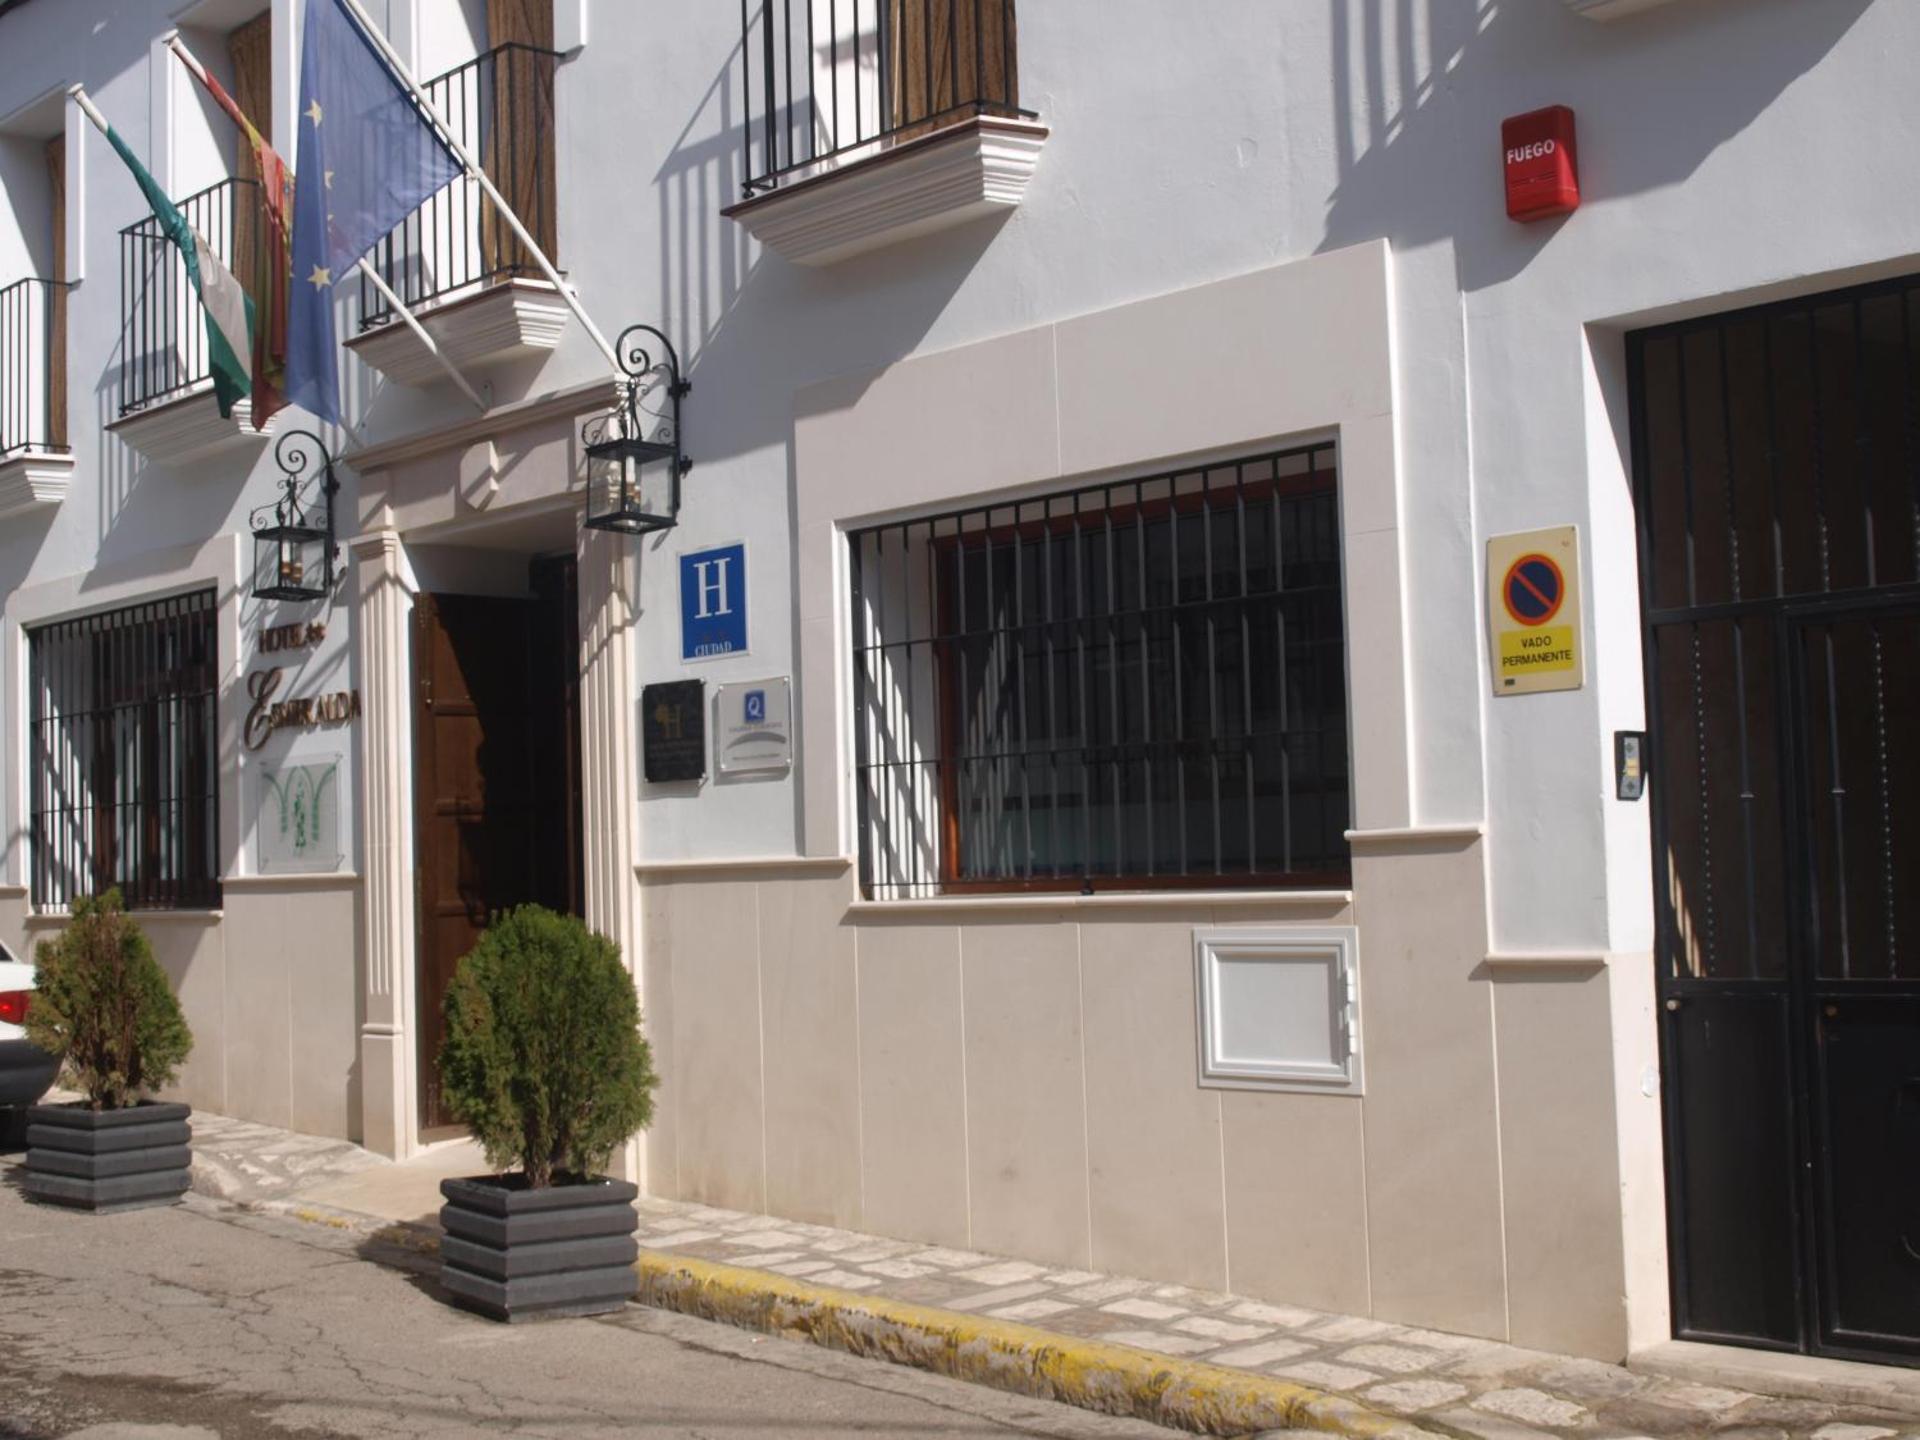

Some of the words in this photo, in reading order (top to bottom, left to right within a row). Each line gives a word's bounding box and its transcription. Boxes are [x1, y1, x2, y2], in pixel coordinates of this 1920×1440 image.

[1507, 139, 1555, 164] FUEGO
[693, 557, 732, 619] H
[258, 623, 304, 654] HOTEL
[695, 640, 732, 657] CIUDAD
[1521, 636, 1552, 648] VADO
[1502, 649, 1572, 667] PERMANENTE
[748, 696, 762, 717] Q
